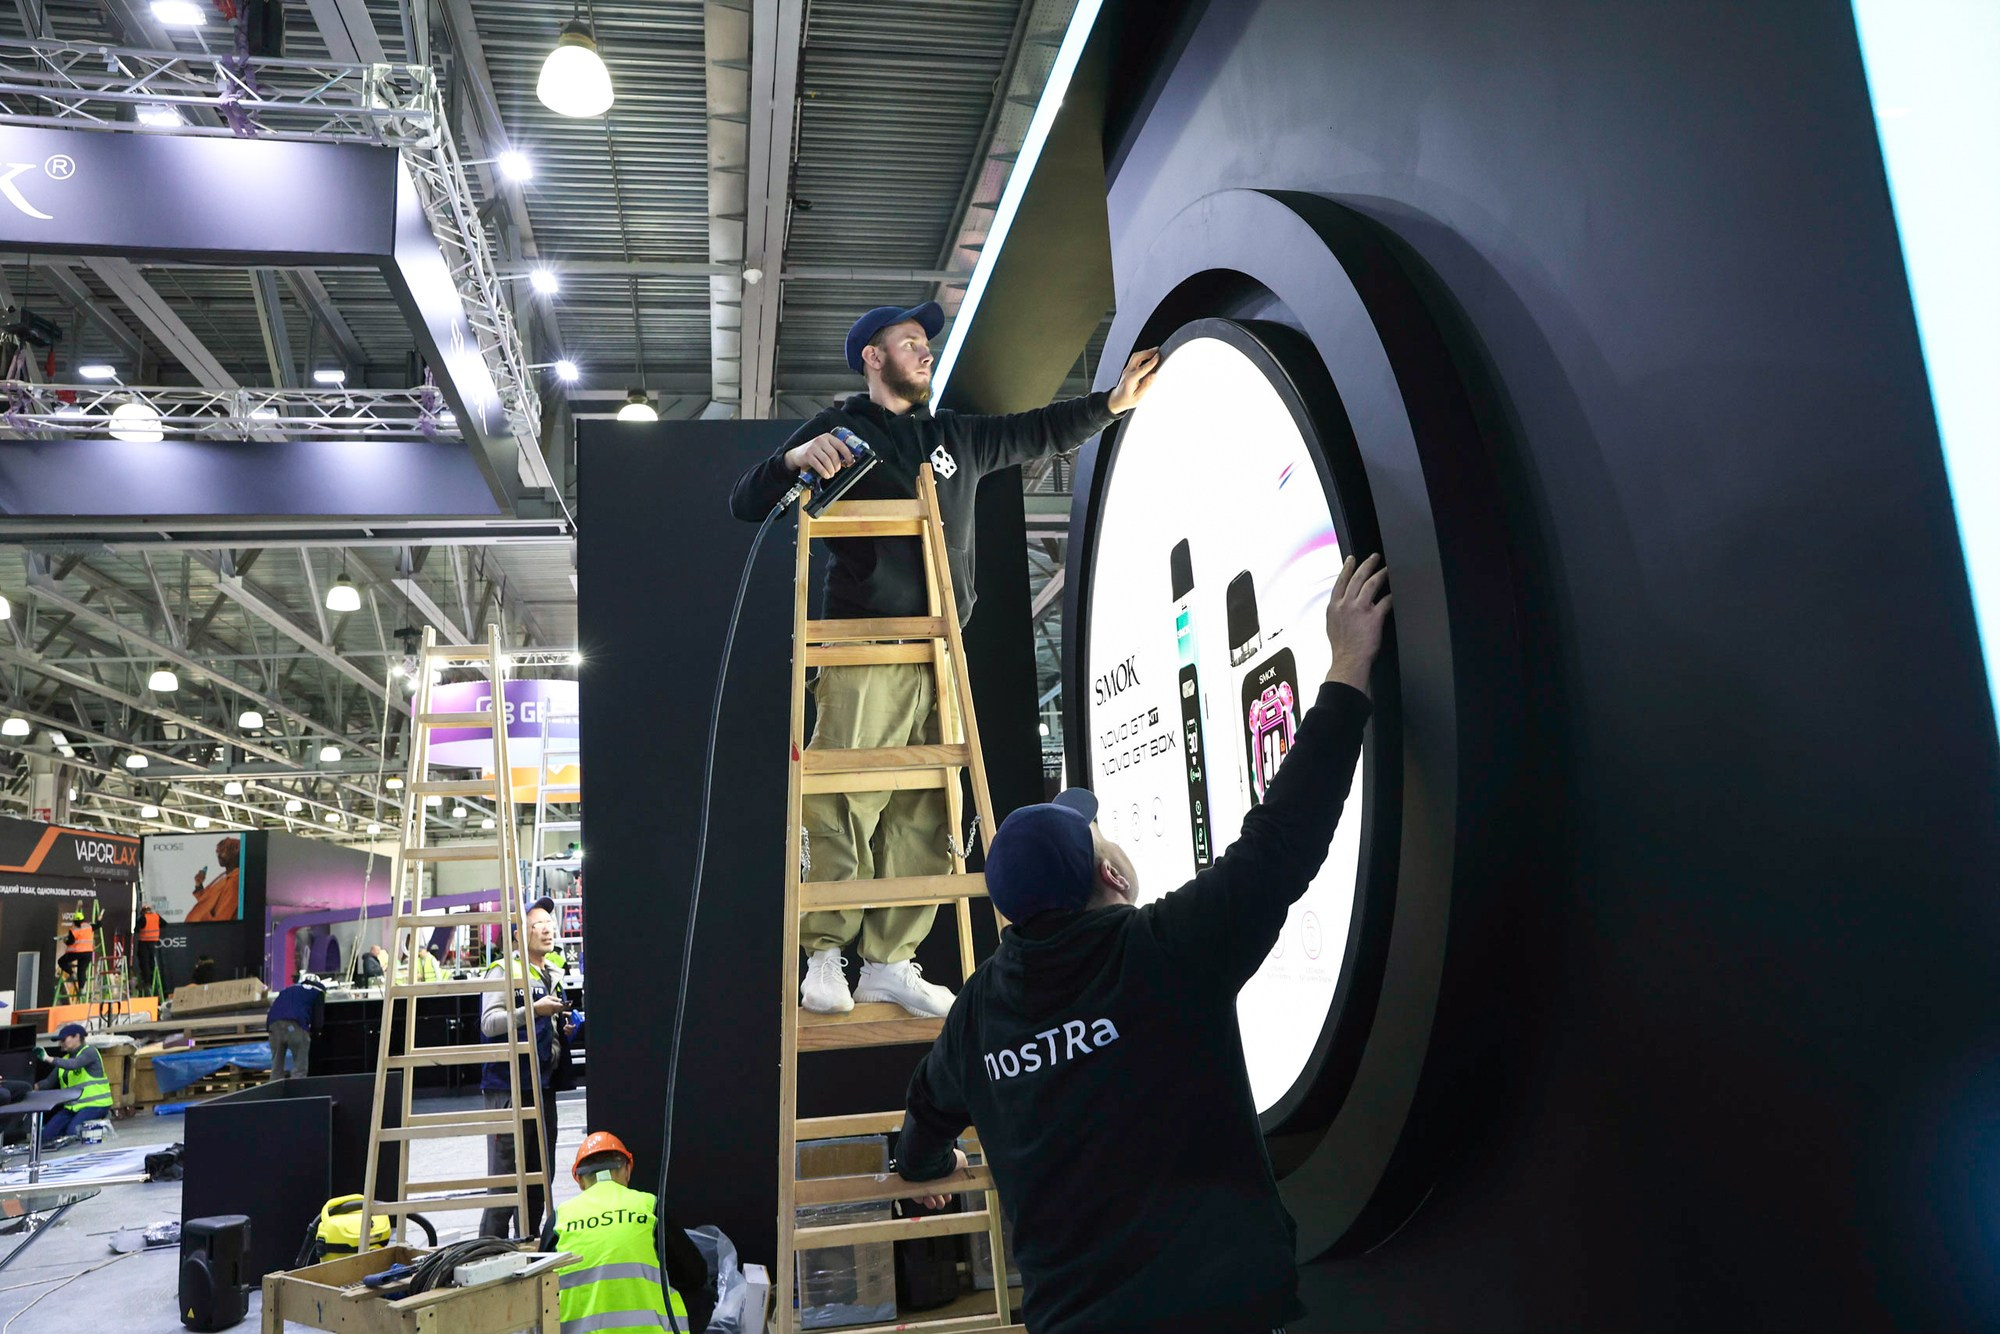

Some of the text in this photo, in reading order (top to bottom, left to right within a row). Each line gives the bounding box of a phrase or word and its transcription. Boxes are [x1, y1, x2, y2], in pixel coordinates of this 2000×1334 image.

[1095, 655, 1141, 706] SMOK
[1258, 666, 1276, 684] SMOK
[1131, 713, 1145, 735] GT
[1133, 743, 1148, 764] GT
[1150, 731, 1176, 757] BOX
[75, 839, 137, 867] VAPORLAX
[154, 937, 187, 948] OSE
